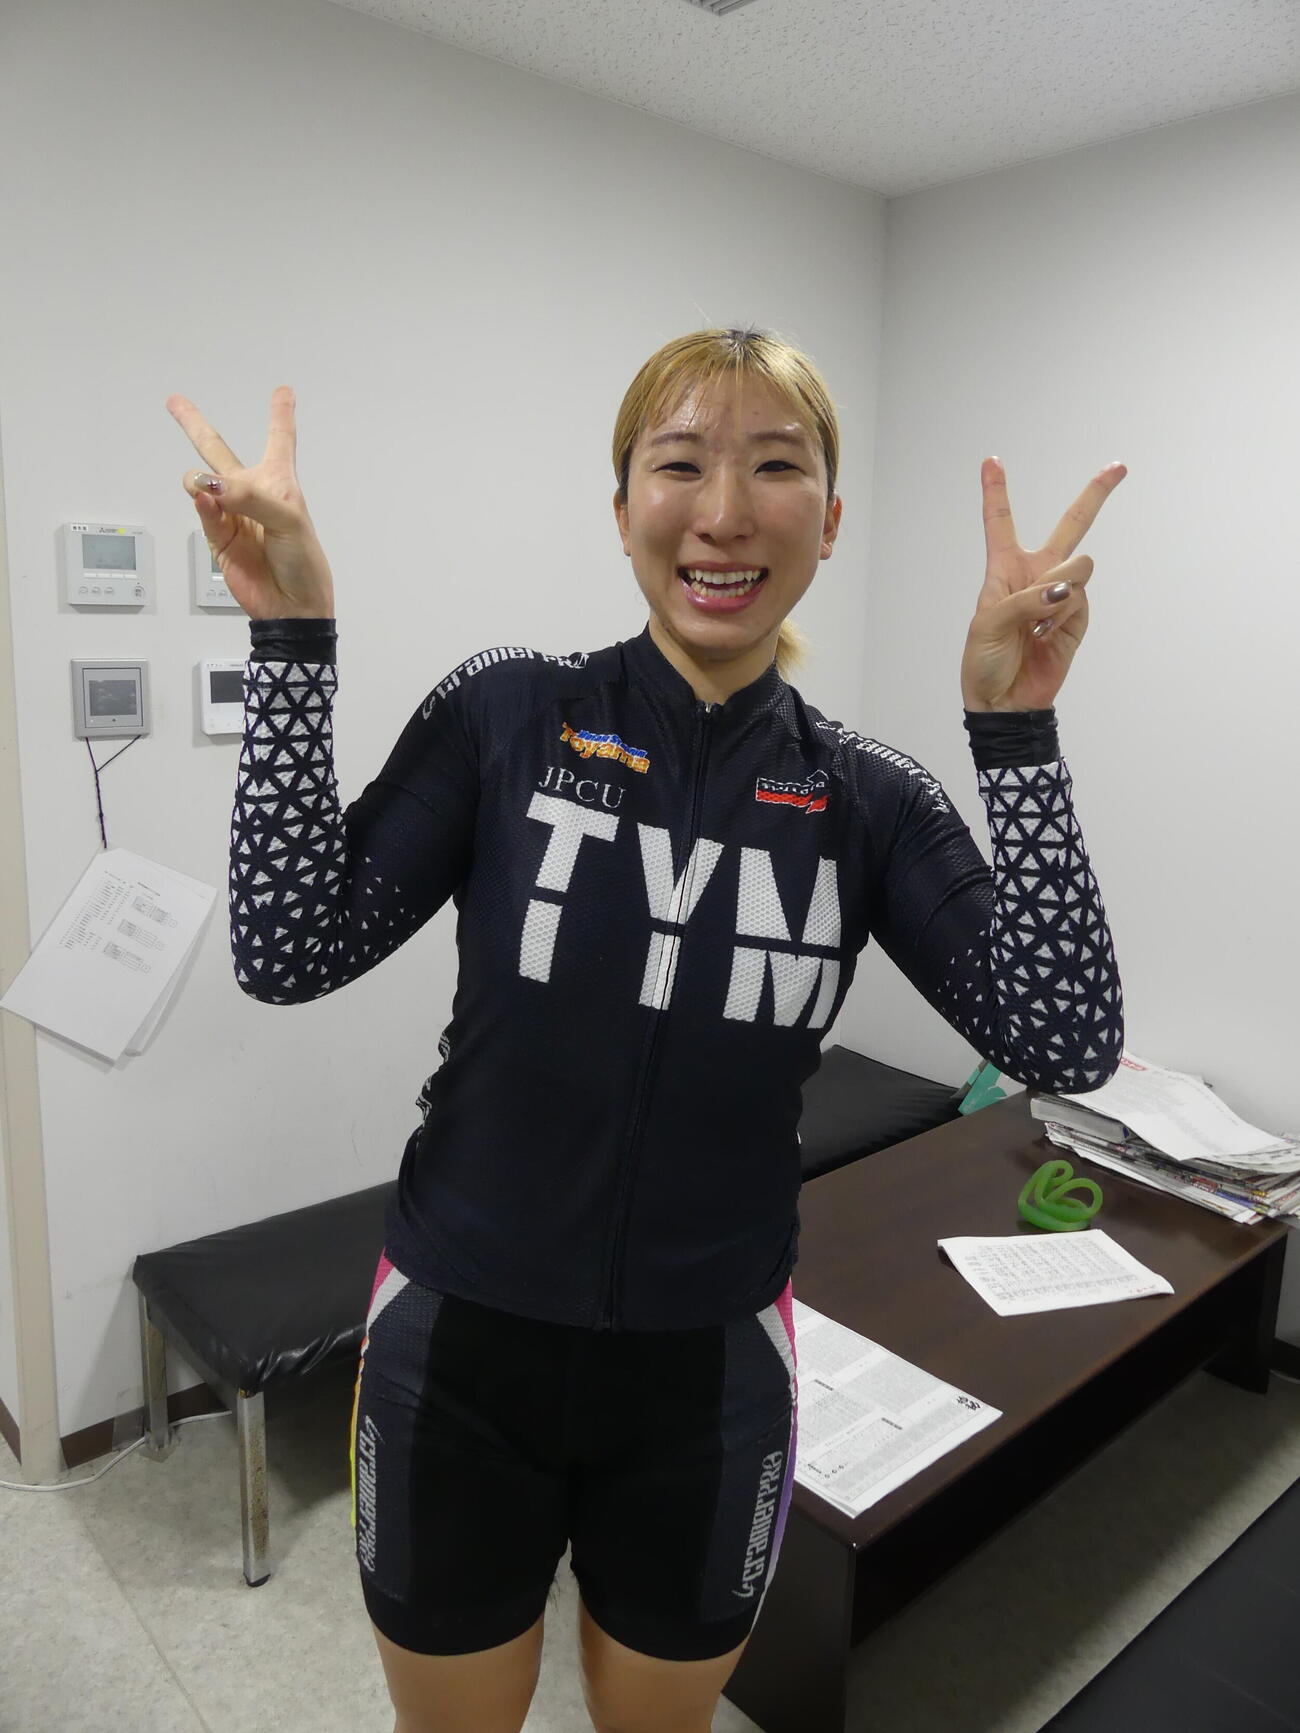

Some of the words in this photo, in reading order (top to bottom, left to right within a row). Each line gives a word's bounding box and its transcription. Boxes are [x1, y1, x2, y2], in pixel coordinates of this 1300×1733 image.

[560, 721, 651, 774] Toyama
[538, 766, 627, 809] JPCU
[518, 791, 842, 1029] TYM
